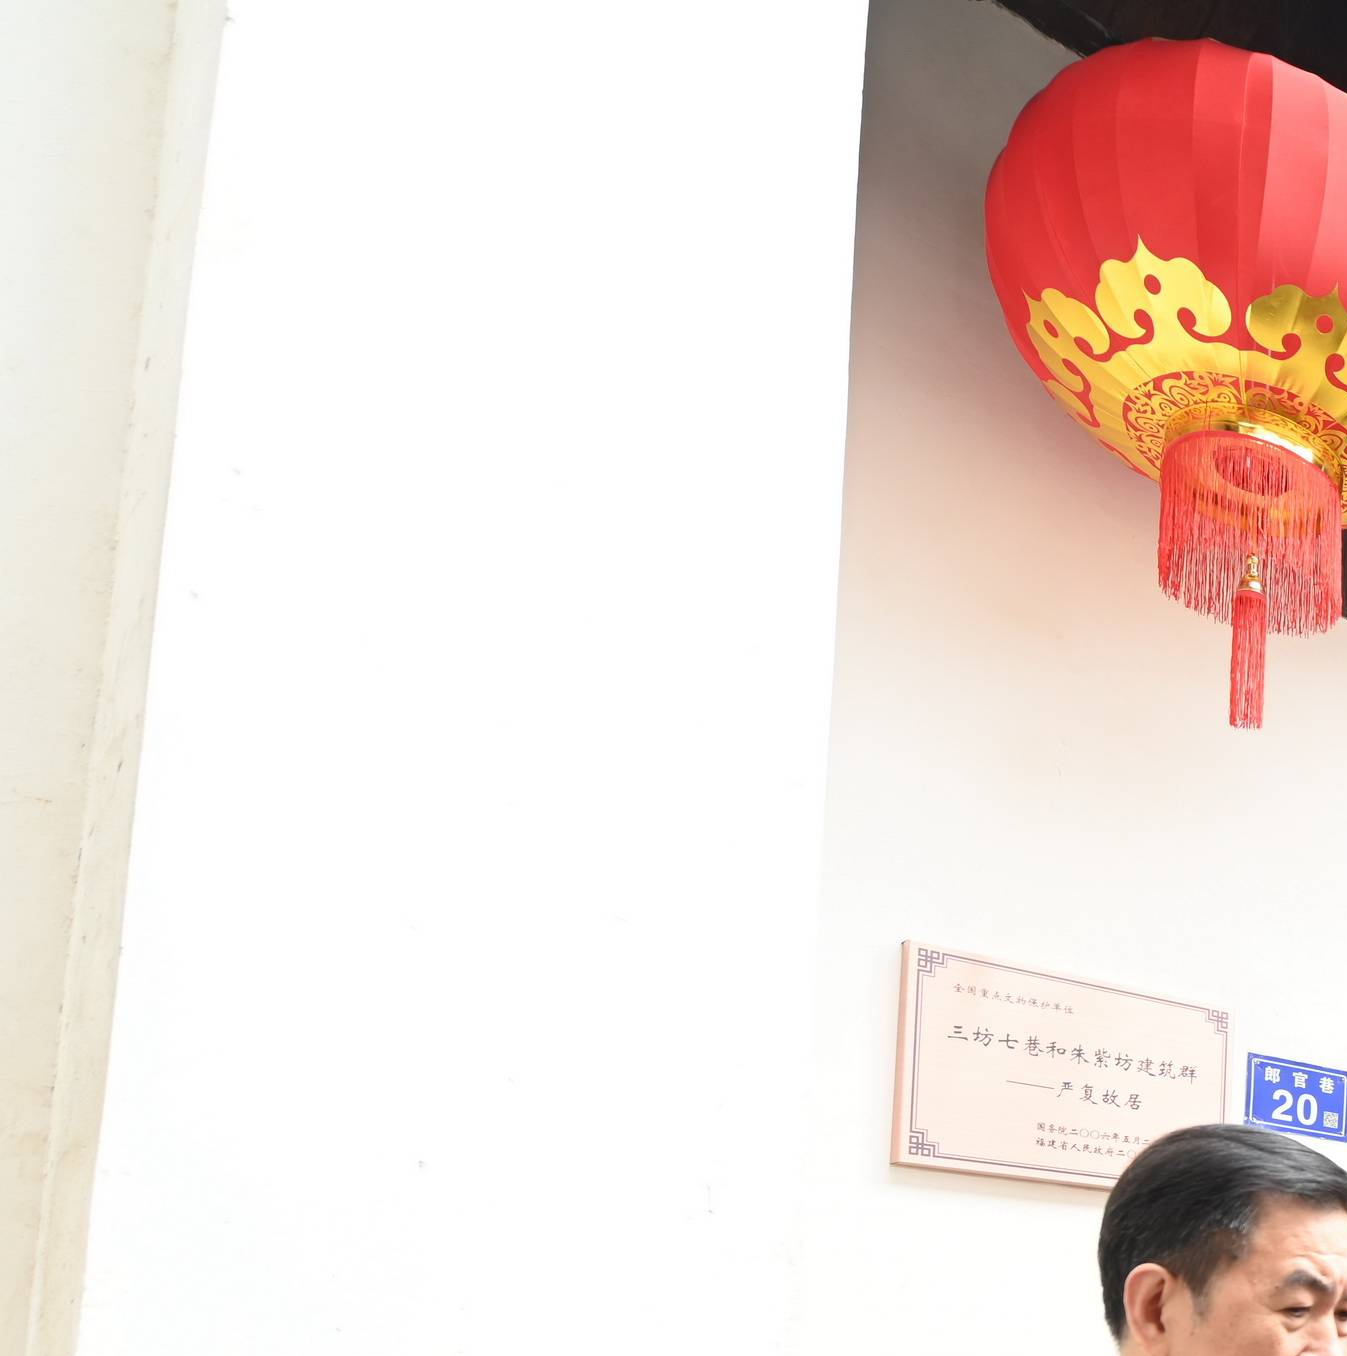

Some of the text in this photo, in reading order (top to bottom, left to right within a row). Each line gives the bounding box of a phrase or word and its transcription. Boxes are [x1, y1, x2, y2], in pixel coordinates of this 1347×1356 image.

[952, 983, 1075, 1015] 全国重点文物保护单位
[947, 1025, 1199, 1085] 三坊七巷和朱紫坊建筑群
[1264, 1065, 1335, 1095] 郎官巷
[1271, 1088, 1318, 1126] 20
